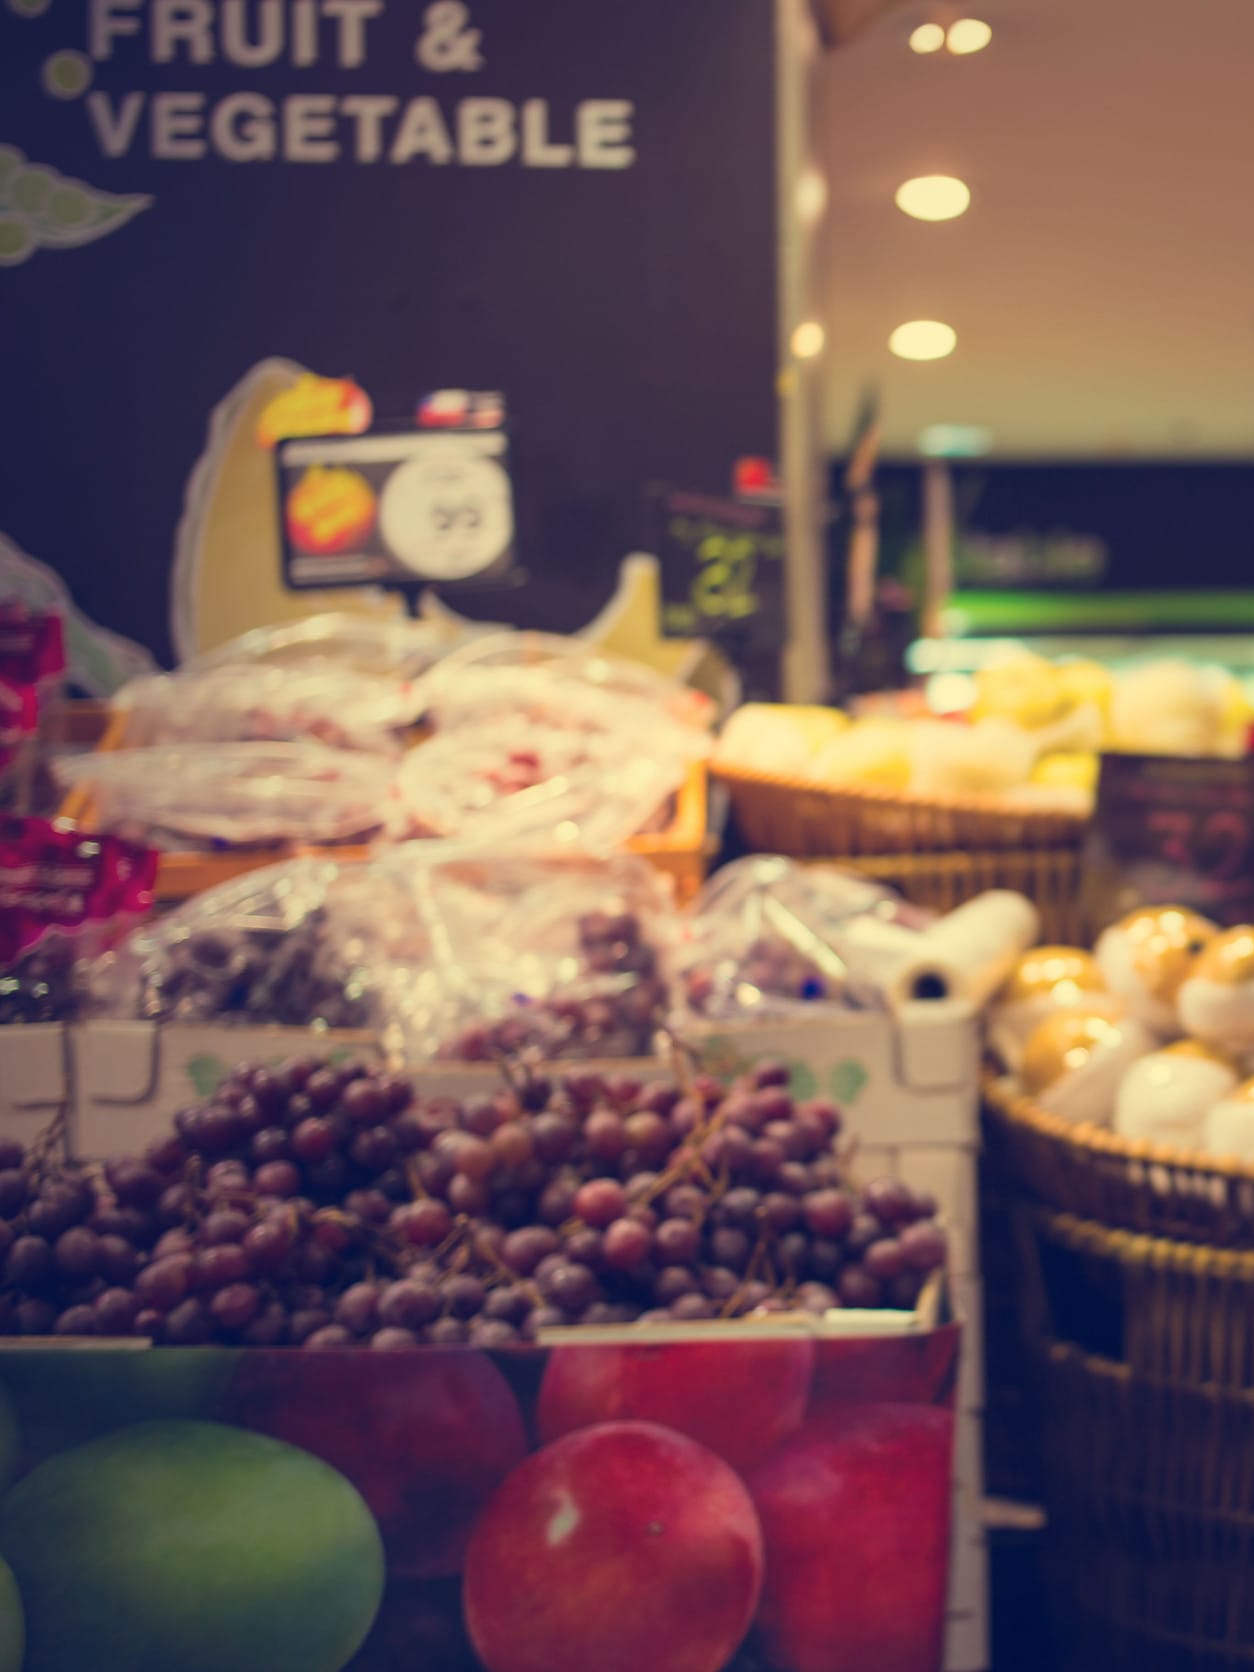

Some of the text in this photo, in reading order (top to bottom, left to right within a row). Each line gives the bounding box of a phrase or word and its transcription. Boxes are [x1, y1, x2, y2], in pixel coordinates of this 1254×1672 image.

[90, 0, 485, 72] FRUIT &
[87, 91, 635, 168] VEGETABLE
